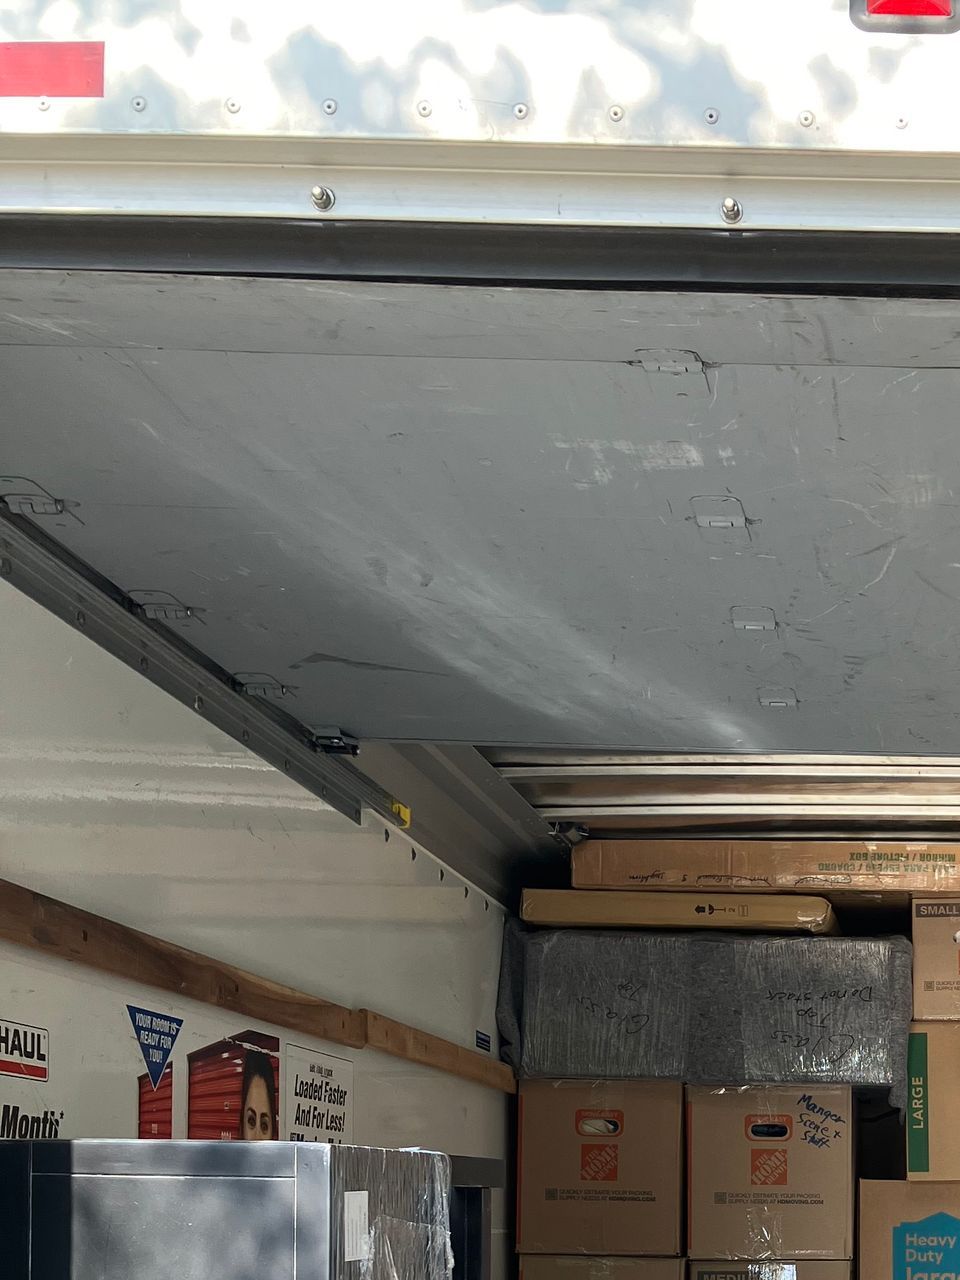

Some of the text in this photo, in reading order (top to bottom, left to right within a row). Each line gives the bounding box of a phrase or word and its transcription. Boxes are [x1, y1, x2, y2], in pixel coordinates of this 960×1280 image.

[920, 906, 959, 915] SMALL
[767, 986, 873, 1004] Do not stack
[135, 1013, 151, 1027] YOUR
[152, 1017, 170, 1031] ROOM
[797, 1008, 831, 1028] Top
[140, 1031, 172, 1049] READY FOR
[770, 1030, 855, 1064] Glass
[150, 1050, 163, 1063] YOU!
[294, 1074, 347, 1106] Loaded Faster
[797, 1094, 845, 1124] Manger
[912, 1076, 925, 1130] LARGE
[295, 1103, 345, 1132] And For Less!
[796, 1113, 829, 1138] Scene
[751, 1149, 787, 1184] HOME
[906, 1233, 957, 1249] Heavy
[906, 1249, 944, 1265] Duty
